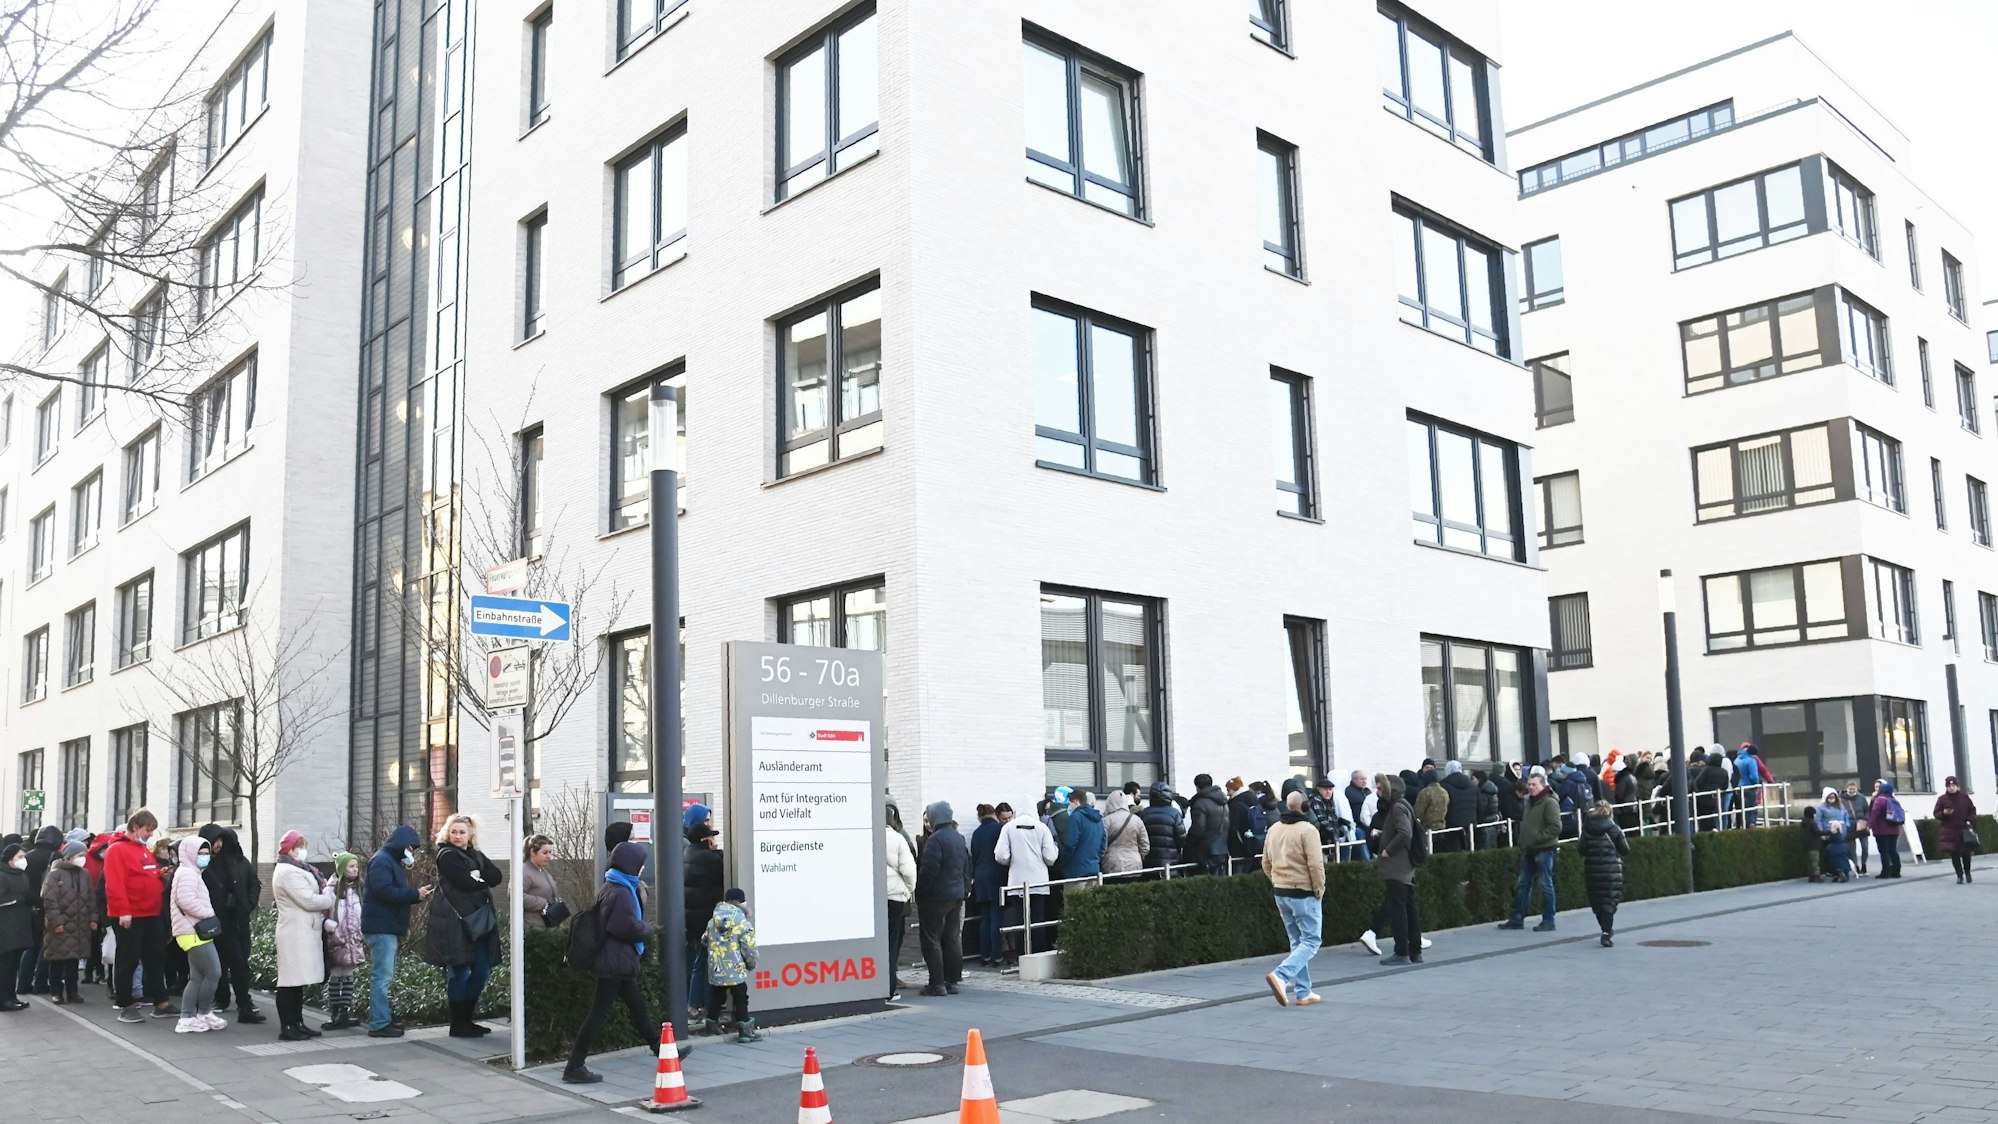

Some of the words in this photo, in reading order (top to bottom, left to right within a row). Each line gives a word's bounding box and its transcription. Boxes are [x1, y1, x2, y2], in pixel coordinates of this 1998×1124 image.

[476, 610, 542, 624] Einbahnstraße
[761, 655, 791, 683] 56
[815, 659, 860, 687] 70a
[761, 693, 825, 709] Dillenburger
[828, 696, 860, 708] Straße
[759, 760, 823, 772] Ausländeramt
[759, 793, 779, 803] Amt
[781, 792, 795, 803] für
[796, 793, 847, 806] Integration
[759, 808, 777, 819] und
[779, 807, 812, 819] Vielfalt
[760, 841, 824, 854] Bürgerdienste
[761, 863, 797, 872] Wahlamt
[781, 957, 876, 987] OSMAB
